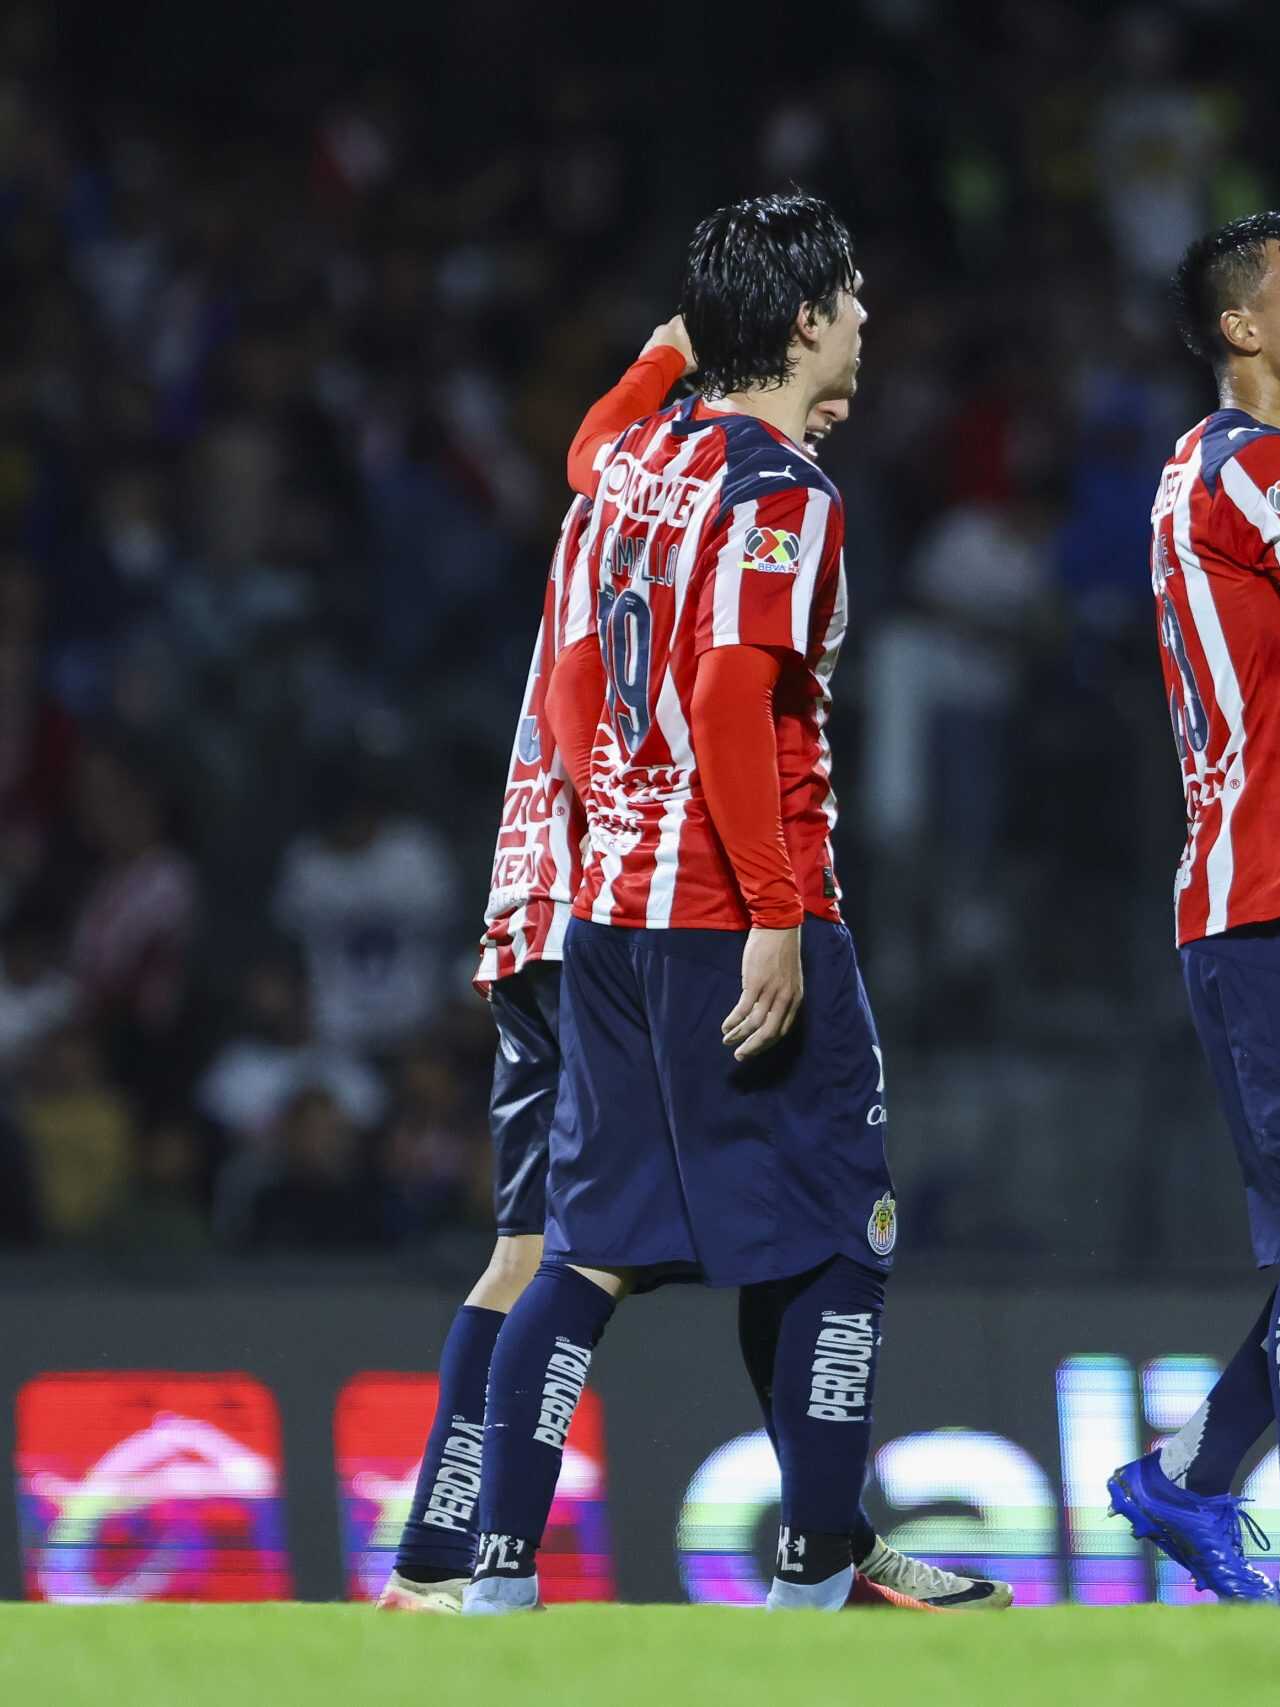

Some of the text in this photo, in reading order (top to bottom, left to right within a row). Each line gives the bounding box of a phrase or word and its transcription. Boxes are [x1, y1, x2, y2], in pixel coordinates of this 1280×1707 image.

[532, 1338, 593, 1450] PERDURA
[806, 1311, 874, 1422] PERDURA
[423, 1416, 486, 1533] PERDURA
